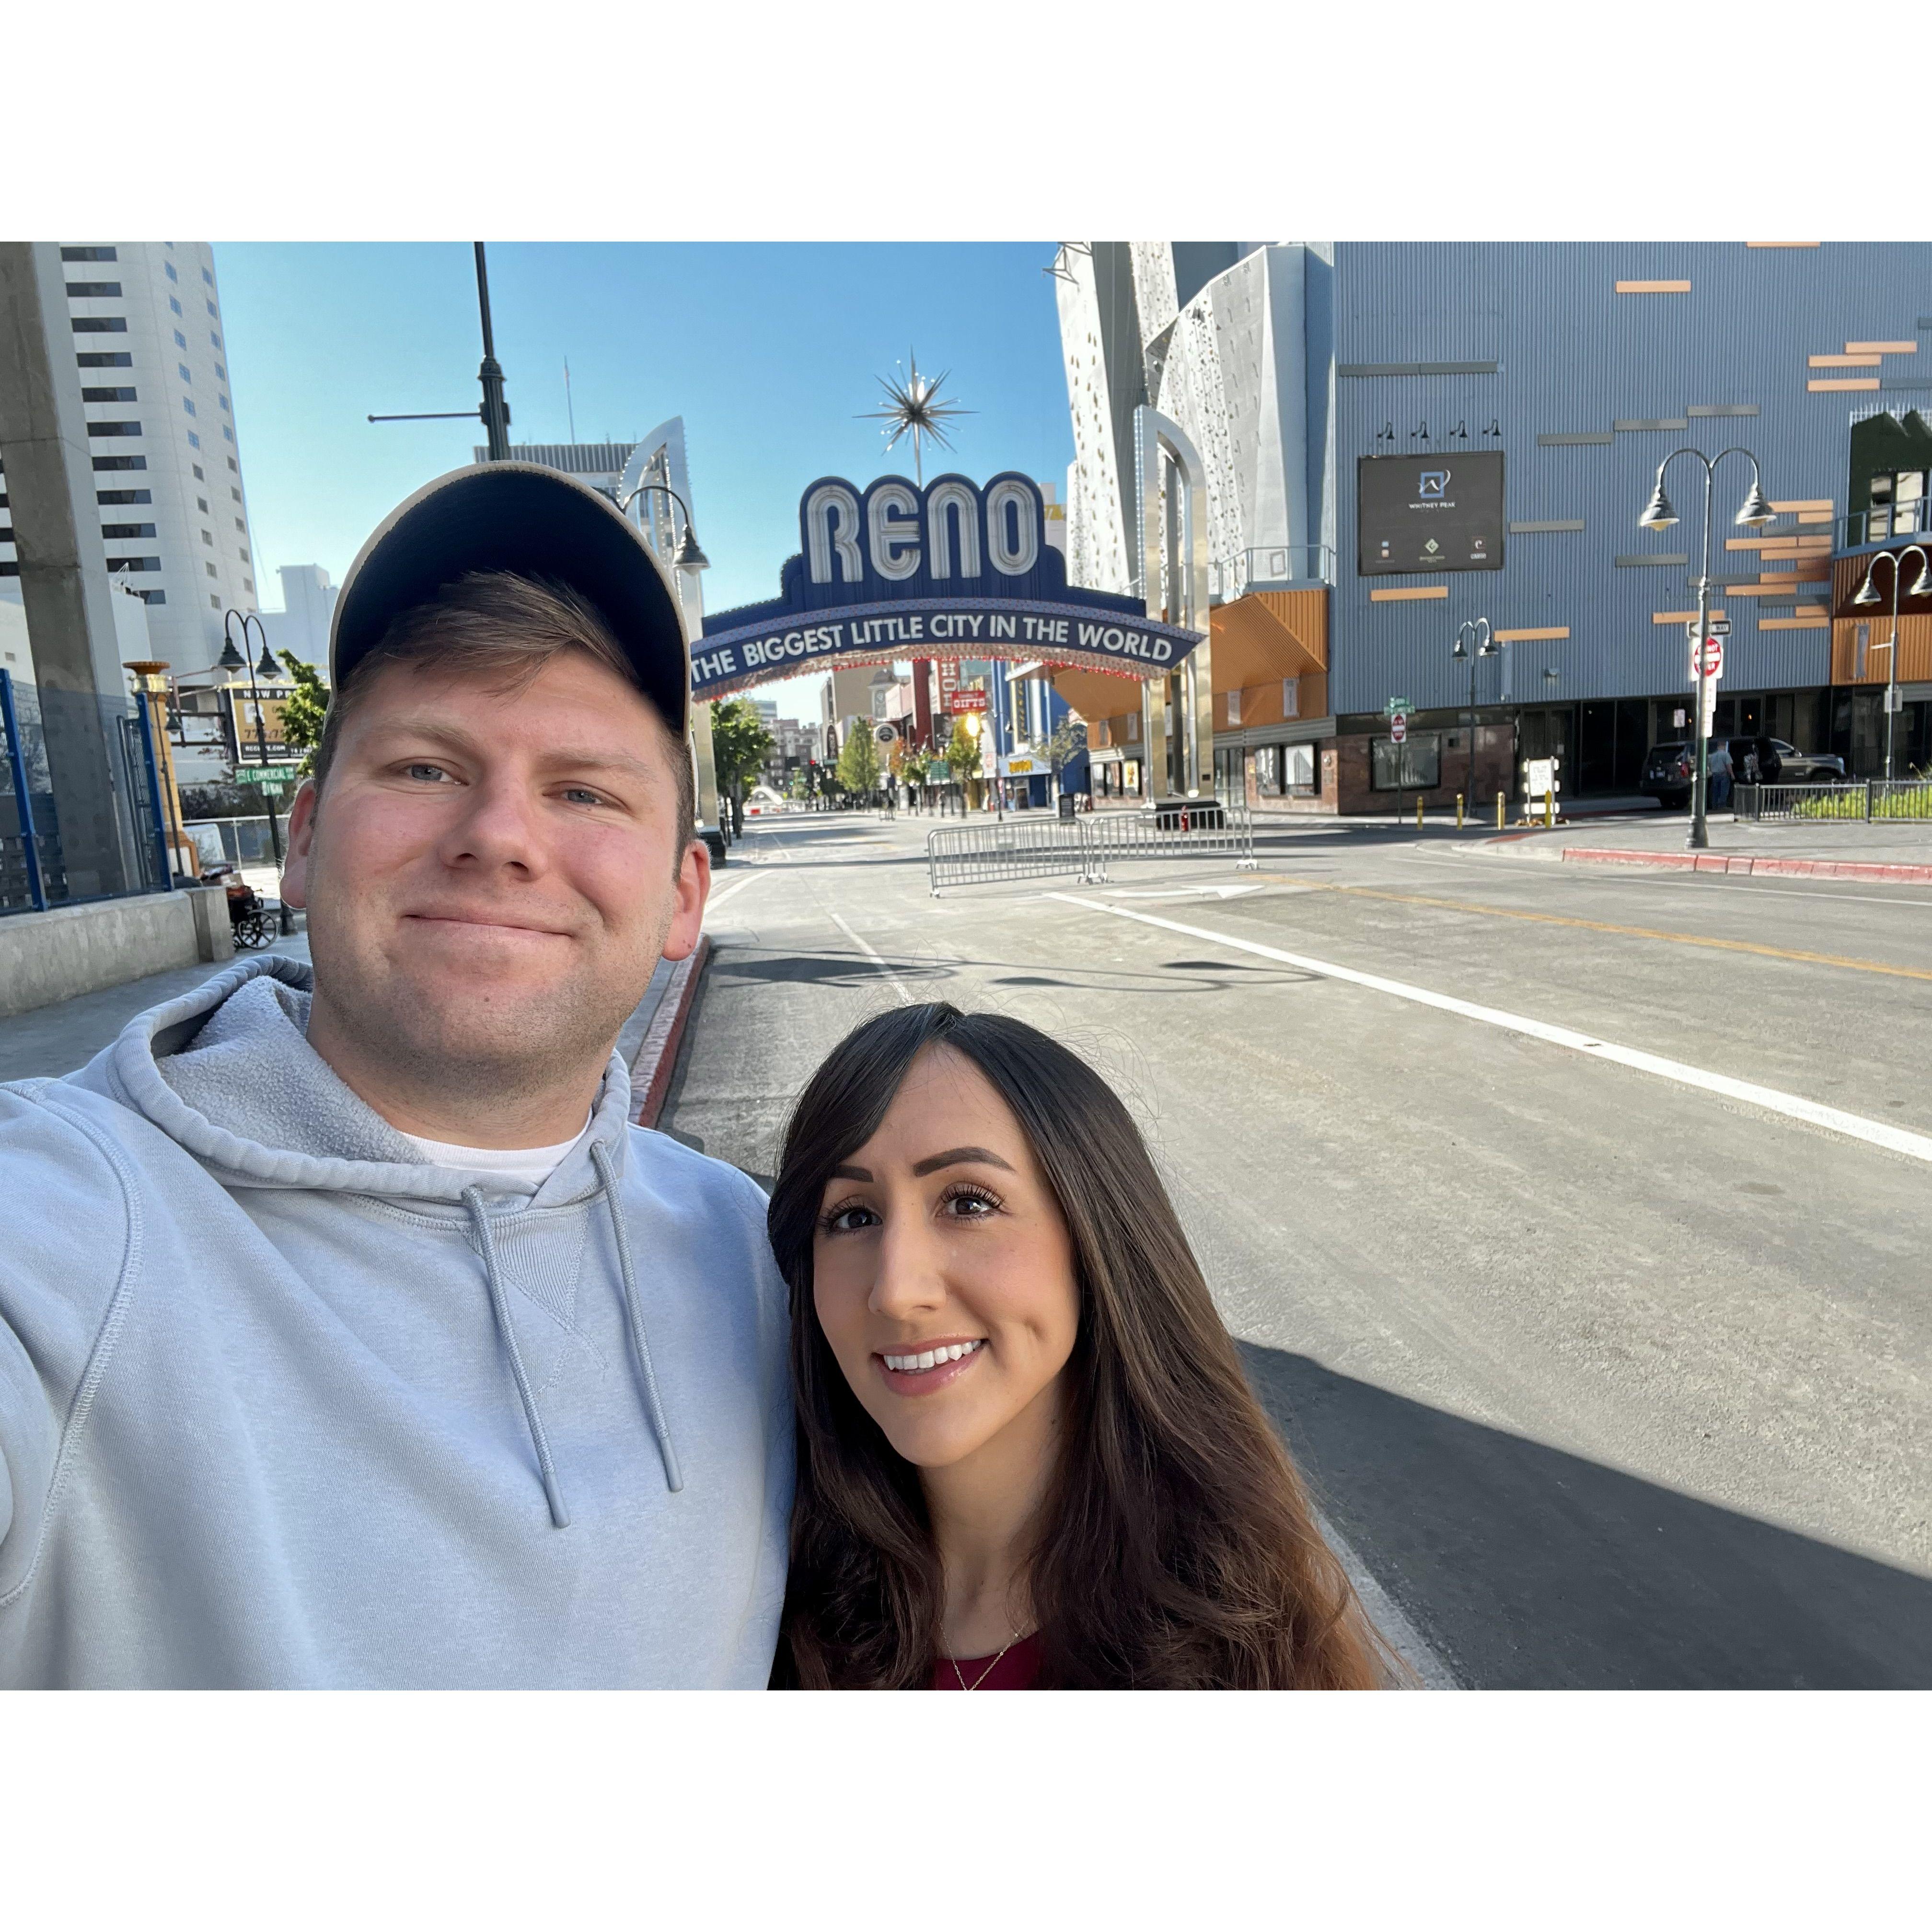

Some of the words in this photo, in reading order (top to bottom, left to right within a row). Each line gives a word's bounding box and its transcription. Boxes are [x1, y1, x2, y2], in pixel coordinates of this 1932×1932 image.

[807, 480, 1039, 583] RENO
[690, 649, 737, 683] THE
[742, 625, 844, 668] BIGGEST
[850, 616, 923, 645] LITTLE
[930, 614, 984, 637] CITY
[990, 615, 1016, 638] IN
[1023, 617, 1068, 643] THE
[1078, 623, 1172, 662] WORLD
[953, 698, 985, 708] GIFTS
